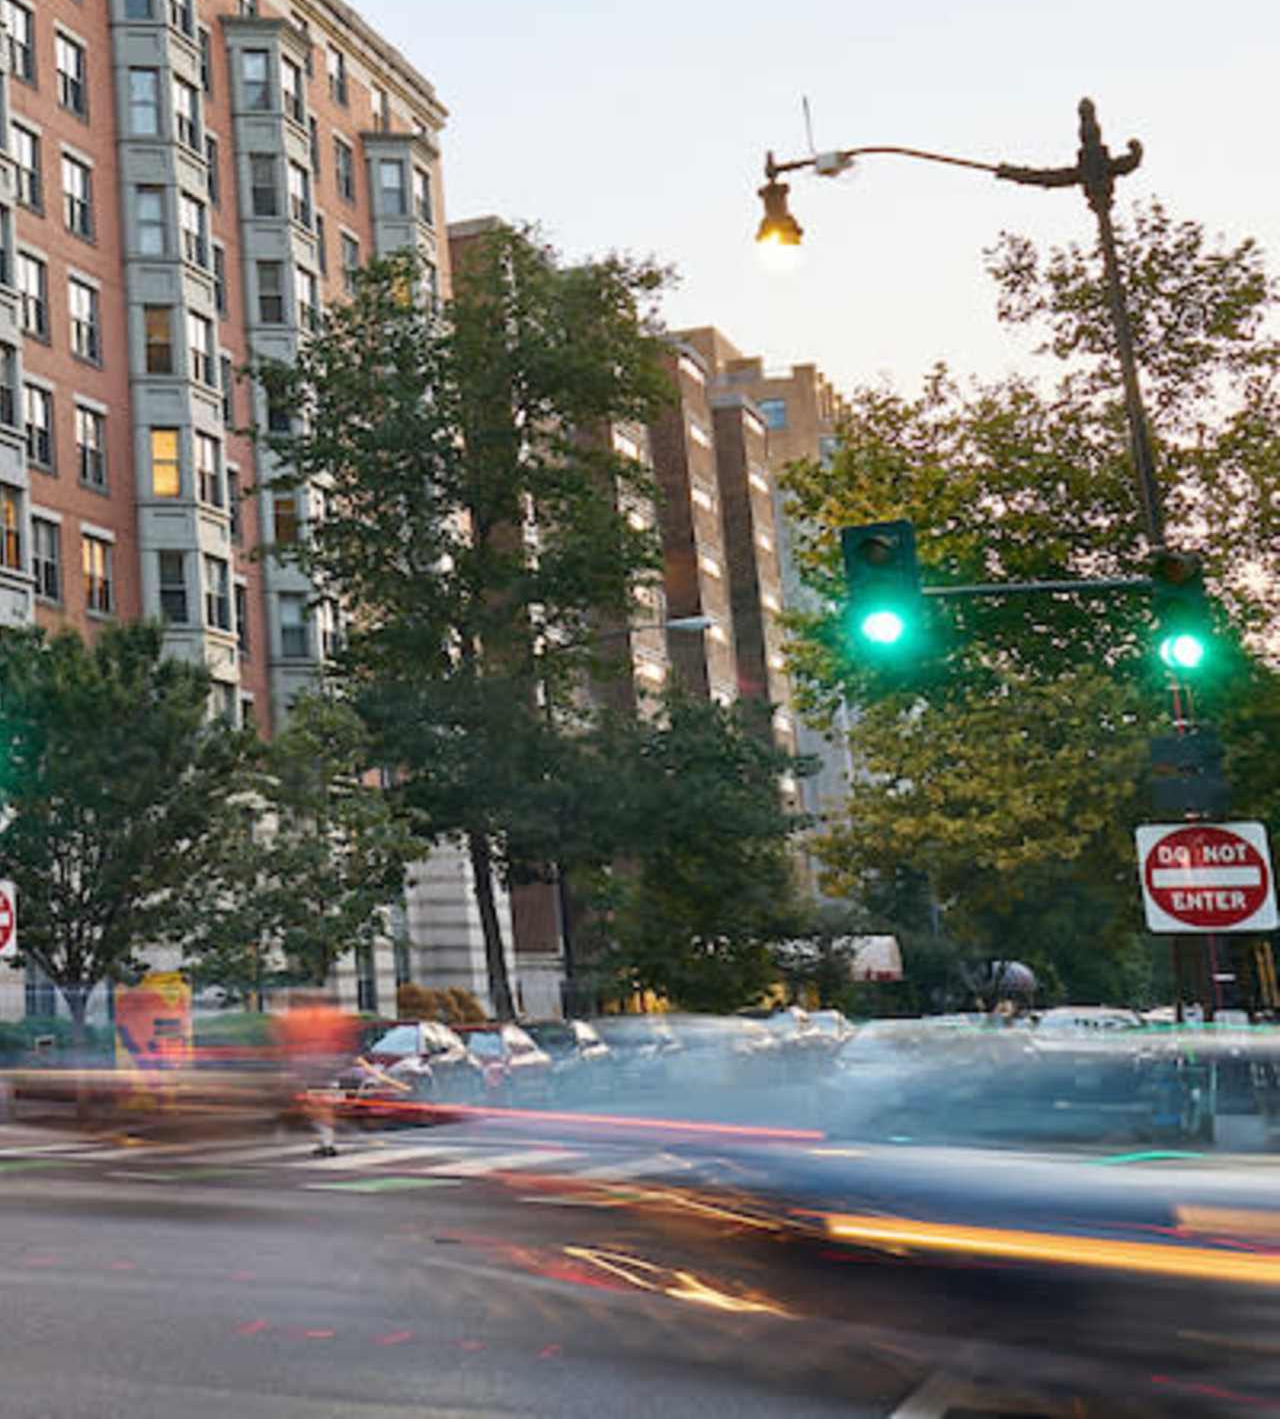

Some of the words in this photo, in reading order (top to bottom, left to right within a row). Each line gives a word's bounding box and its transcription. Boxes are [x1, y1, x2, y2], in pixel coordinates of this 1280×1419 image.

[1157, 844, 1190, 864] DO
[1203, 841, 1248, 862] NOT
[1171, 890, 1246, 912] ENTER
